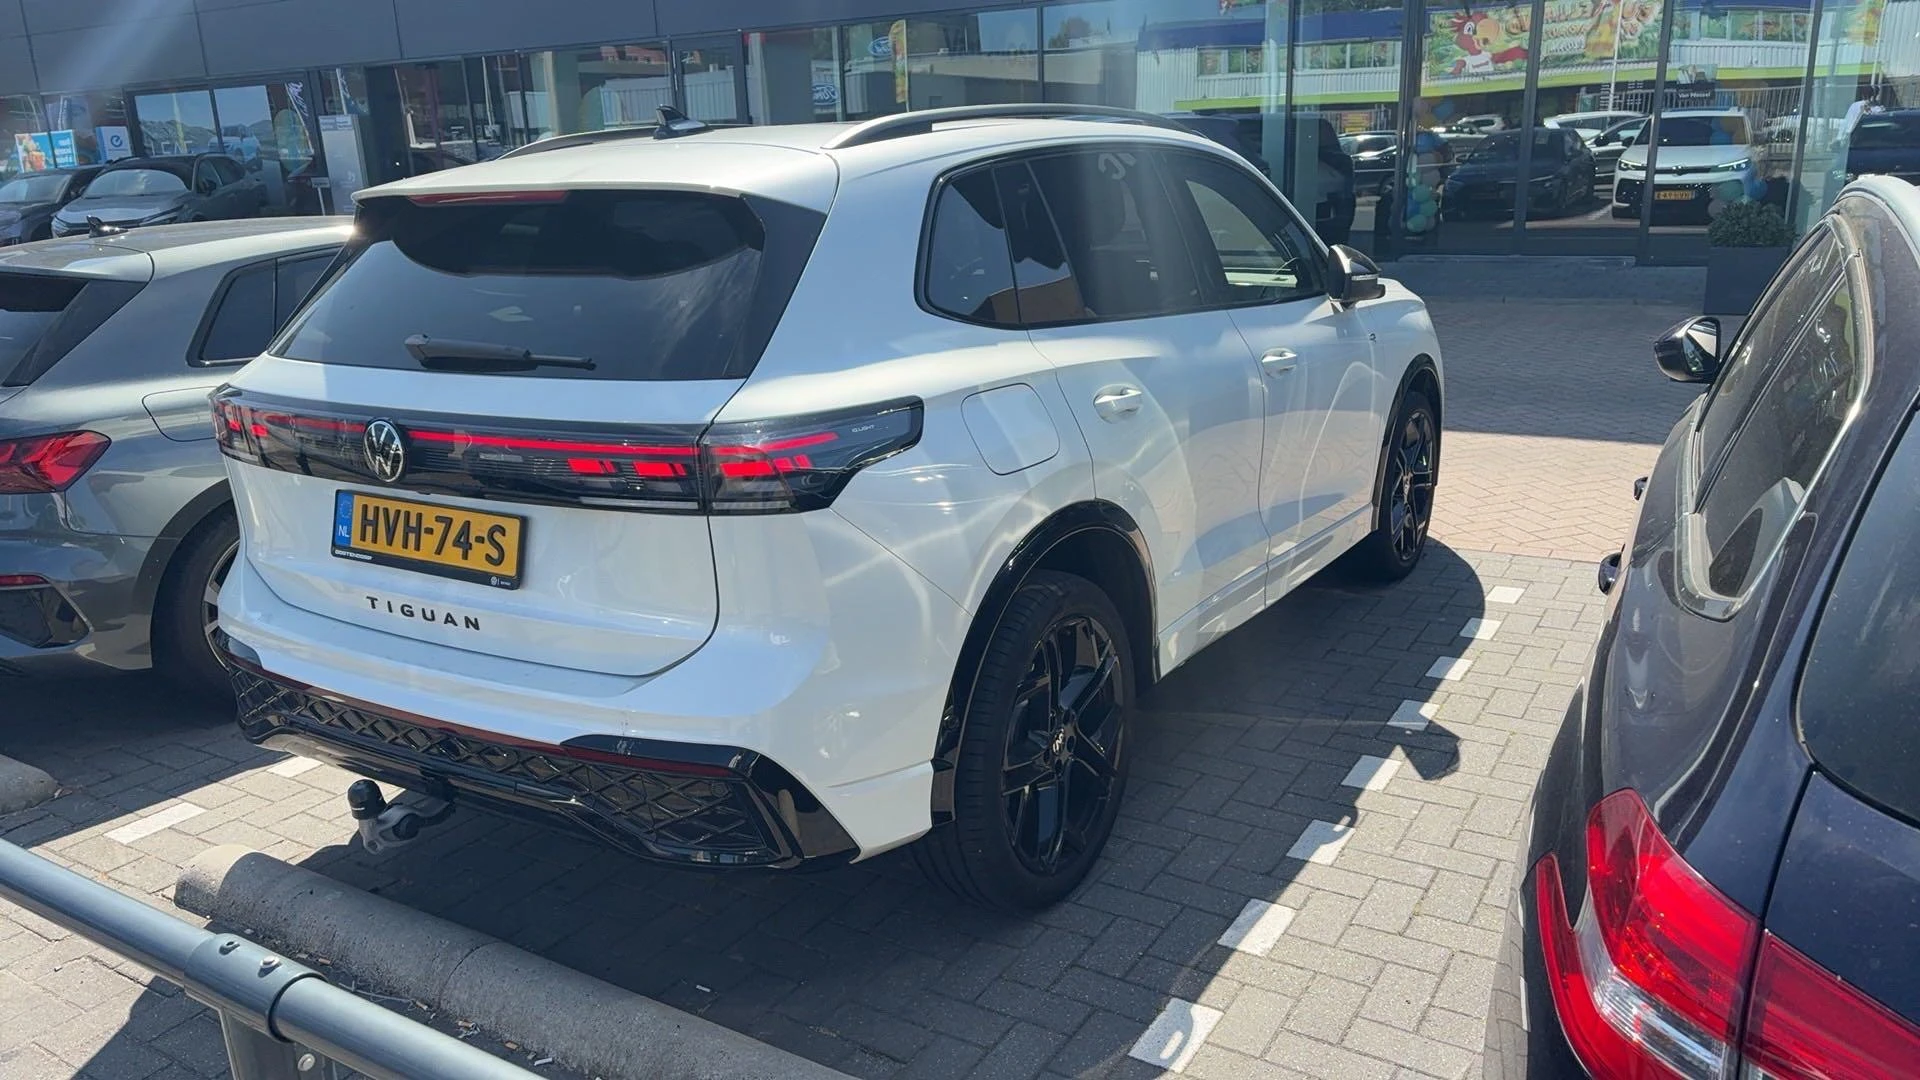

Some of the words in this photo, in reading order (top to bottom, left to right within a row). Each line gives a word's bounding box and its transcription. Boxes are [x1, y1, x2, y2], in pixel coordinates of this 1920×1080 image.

[338, 524, 351, 538] NL
[359, 503, 507, 566] HVH-74-S
[366, 596, 481, 631] TIGUAN
